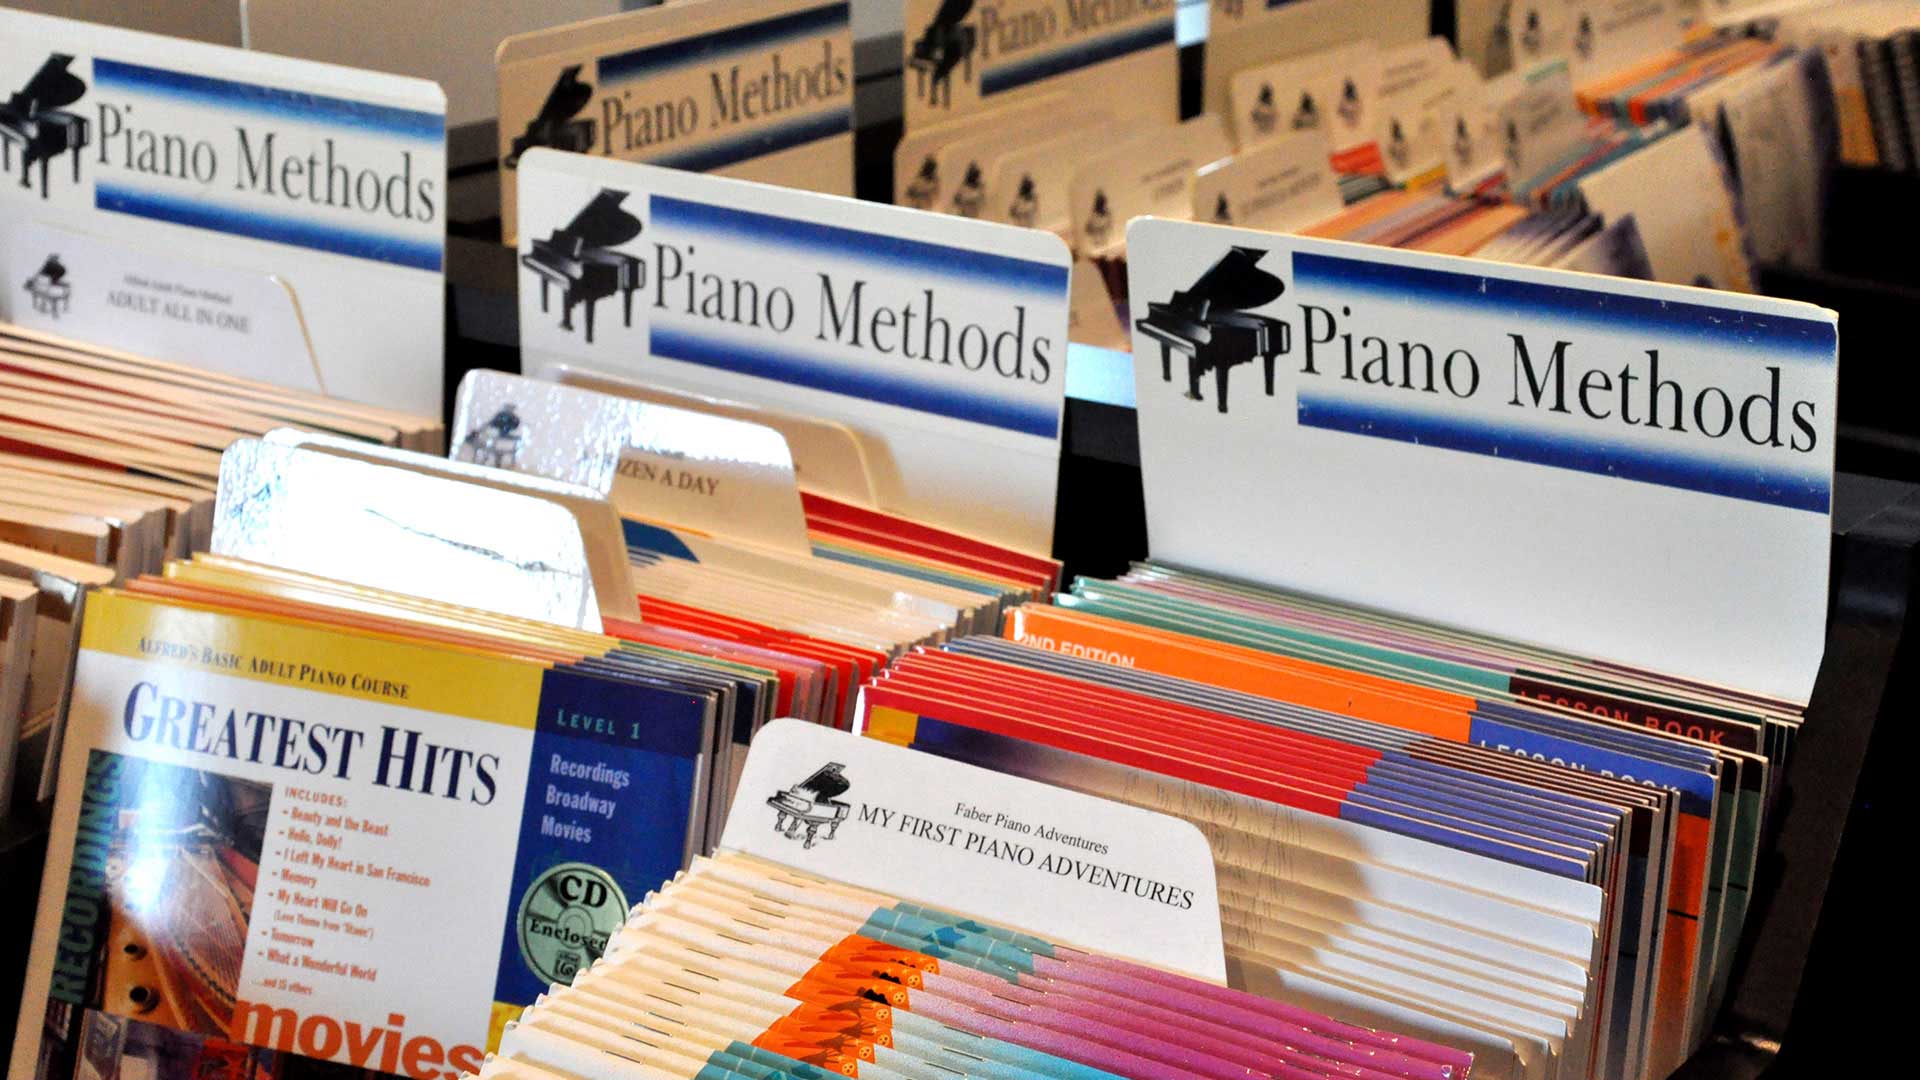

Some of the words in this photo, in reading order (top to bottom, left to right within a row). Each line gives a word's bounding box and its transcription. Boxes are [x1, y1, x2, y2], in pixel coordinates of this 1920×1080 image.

[602, 89, 698, 155] Piano
[709, 40, 849, 129] Methods
[96, 102, 218, 185] Piano
[236, 126, 436, 223] Methods
[107, 289, 159, 315] ADULT
[162, 300, 193, 322] ALL
[195, 307, 214, 326] IN
[215, 310, 250, 334] ONE
[652, 242, 795, 334] Piano
[815, 272, 1052, 385] Methods
[1298, 303, 1481, 398] Piano
[1507, 332, 1819, 453] Methods
[616, 459, 656, 481] ZEN
[659, 468, 673, 487] A
[678, 471, 720, 496] DAY
[201, 646, 242, 670] BASIC
[249, 655, 296, 680] ADULT
[299, 663, 347, 688] PIANO
[351, 673, 410, 699] COURSE
[1060, 641, 1136, 668] EDITION
[123, 680, 365, 782] GREATEST
[371, 725, 500, 806] HITS
[556, 708, 617, 737] LEVEL
[631, 721, 641, 741] 1
[550, 753, 631, 790] Recordings
[285, 785, 348, 808] INCLUDES:
[545, 784, 617, 820] Broadway
[291, 805, 322, 827] Beauty
[325, 815, 342, 829] and
[344, 816, 360, 832] the
[362, 819, 390, 837] Beast
[540, 815, 593, 844] Movies
[954, 802, 993, 823] Faber
[994, 812, 1031, 836] Piano
[1033, 824, 1110, 855] Adventures
[290, 849, 310, 865] Left
[311, 852, 326, 869] My
[327, 855, 353, 874] Heart
[366, 862, 385, 879] San
[386, 866, 432, 888] Francisco
[858, 803, 896, 828] MY
[898, 814, 962, 847] FIRST
[963, 831, 1034, 867] PIANO
[1037, 853, 1195, 911] ADVENTURES
[281, 867, 318, 889] Memory
[560, 874, 608, 909] CD
[277, 888, 291, 905] My
[293, 891, 319, 909] Heart
[271, 927, 315, 950] Tomorrow
[301, 954, 349, 976] Wonderful
[350, 964, 378, 982] World
[229, 999, 486, 1080] movies
